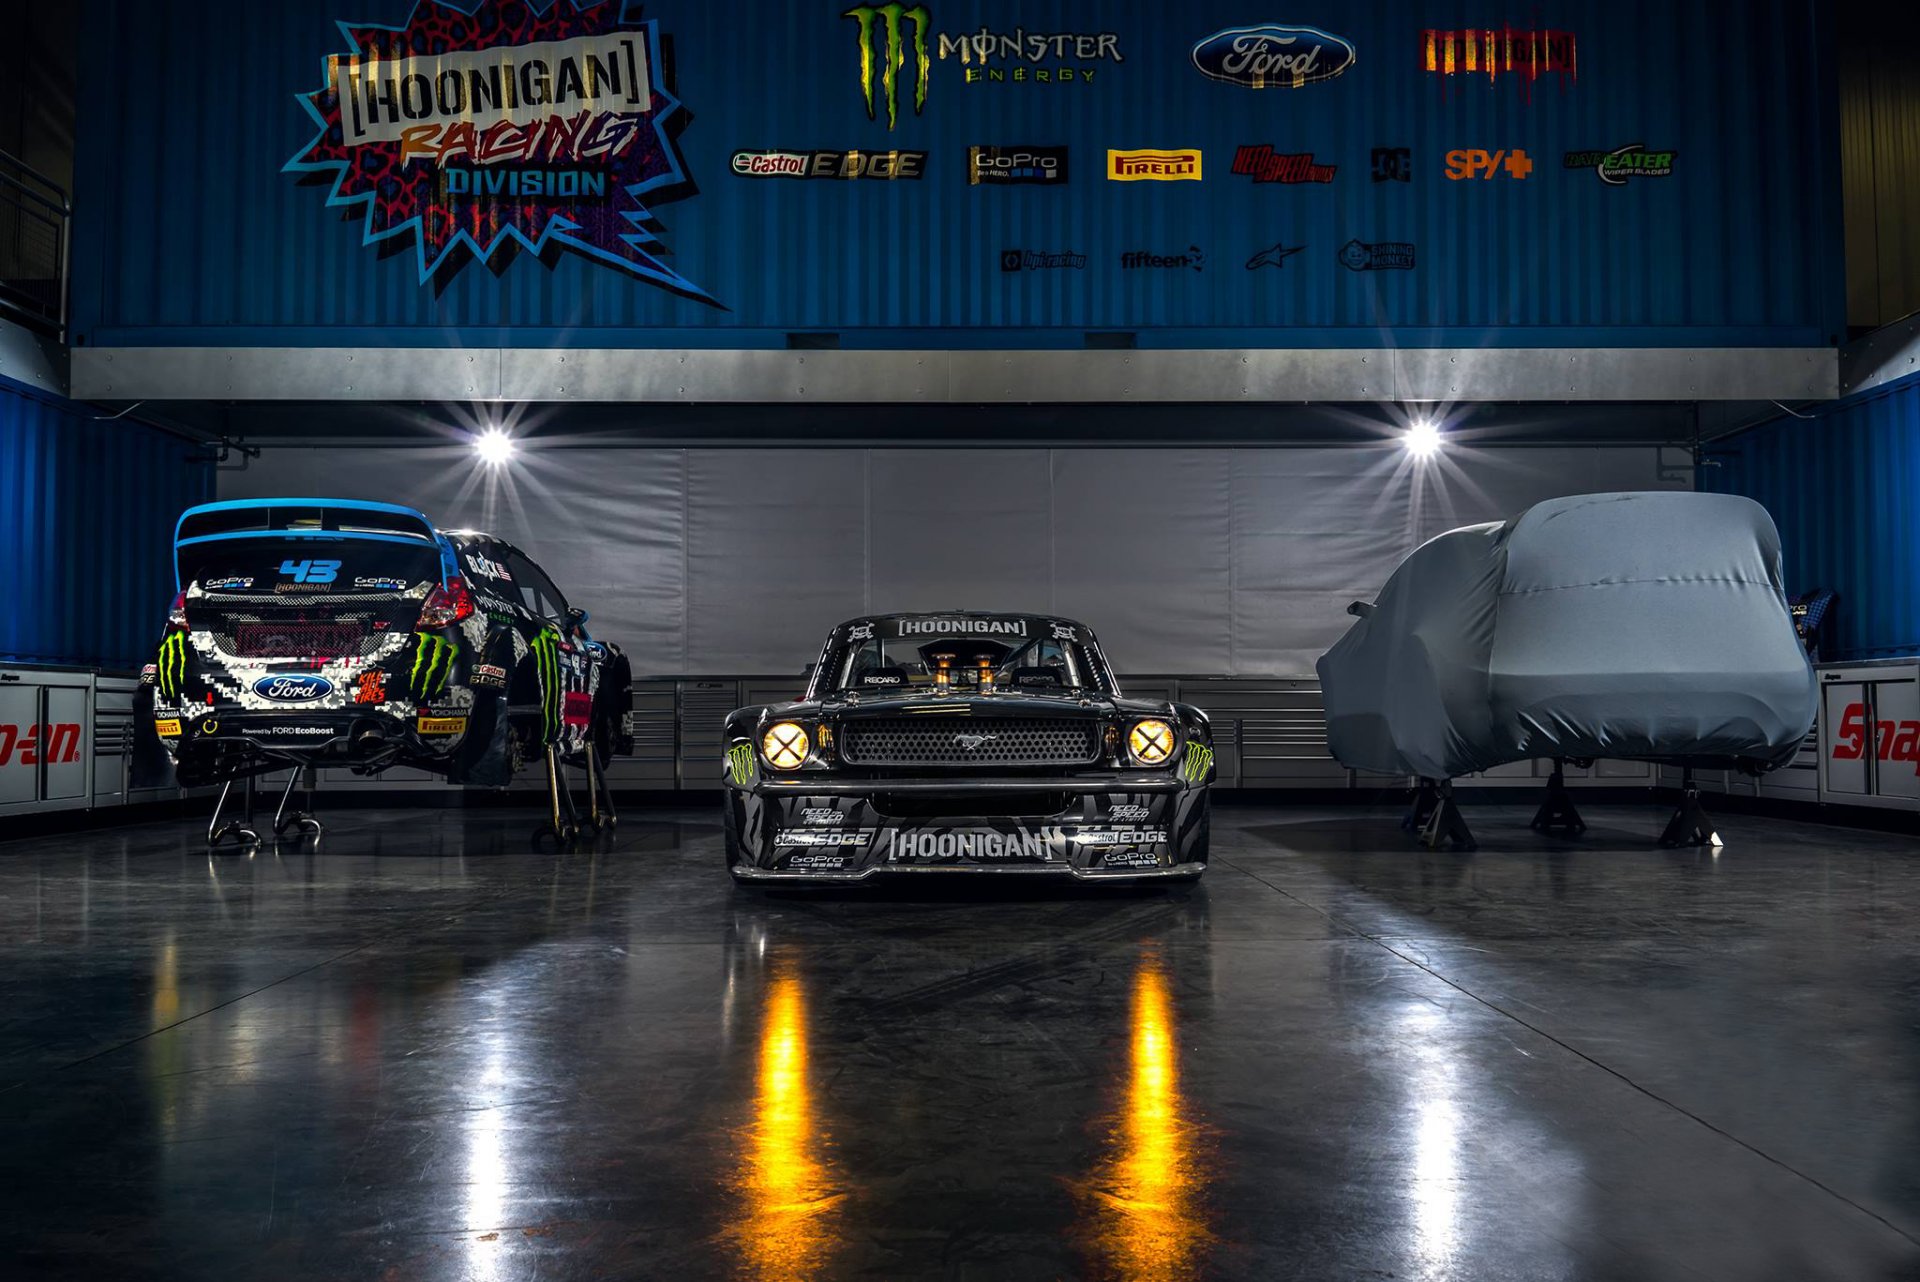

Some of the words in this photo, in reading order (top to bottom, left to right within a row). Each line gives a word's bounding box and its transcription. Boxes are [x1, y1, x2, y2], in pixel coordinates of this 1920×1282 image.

[1222, 35, 1321, 74] Ford
[965, 67, 1095, 83] ENERGY
[399, 109, 639, 170] RACING
[751, 155, 805, 175] Castrol
[811, 153, 923, 176] EDGE
[976, 153, 1057, 167] GoPro
[1115, 156, 1195, 175] PIRELLI
[1233, 146, 1273, 173] NEED
[1264, 154, 1312, 181] SPEED
[445, 167, 605, 197] DIVISION
[1371, 246, 1413, 255] SHINING
[1371, 254, 1413, 267] MONKEY
[279, 560, 342, 584] 43
[206, 577, 254, 586] GoPro
[355, 576, 406, 584] GoPro
[481, 665, 505, 677] Castrol
[470, 675, 506, 688] EDGE
[864, 676, 900, 684] RECARO
[269, 677, 316, 698] Ford
[422, 720, 463, 731] PIRELLI
[814, 834, 870, 845] EDGE
[1119, 831, 1167, 843] EDGE
[790, 855, 844, 863] GoPro
[1104, 853, 1155, 862] GoPro
